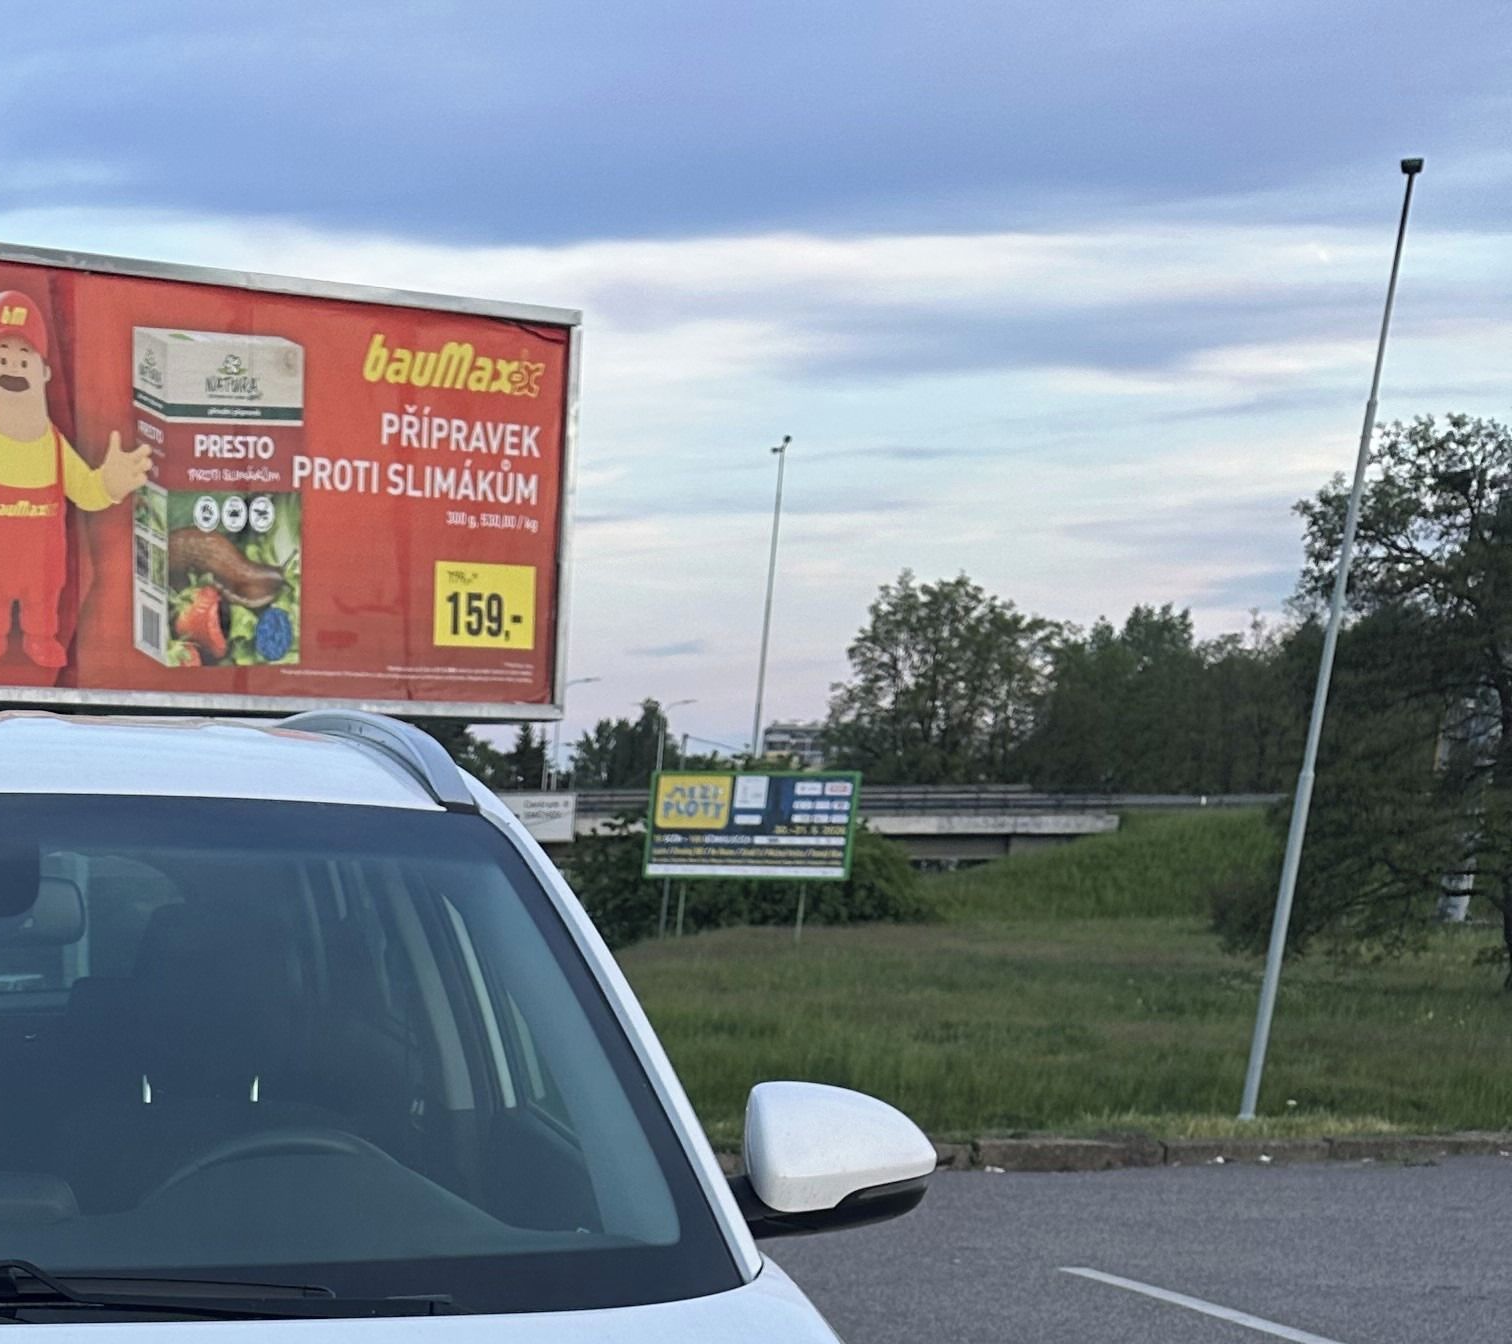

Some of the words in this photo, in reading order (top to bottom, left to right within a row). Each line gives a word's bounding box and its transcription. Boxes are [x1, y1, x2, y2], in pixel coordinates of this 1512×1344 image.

[194, 434, 275, 459] PRESTO
[381, 405, 541, 458] PŘÍPRAVEK
[292, 455, 380, 494] PROTI
[387, 459, 538, 505] SLIMÁKŮM
[446, 591, 523, 642] 159,-
